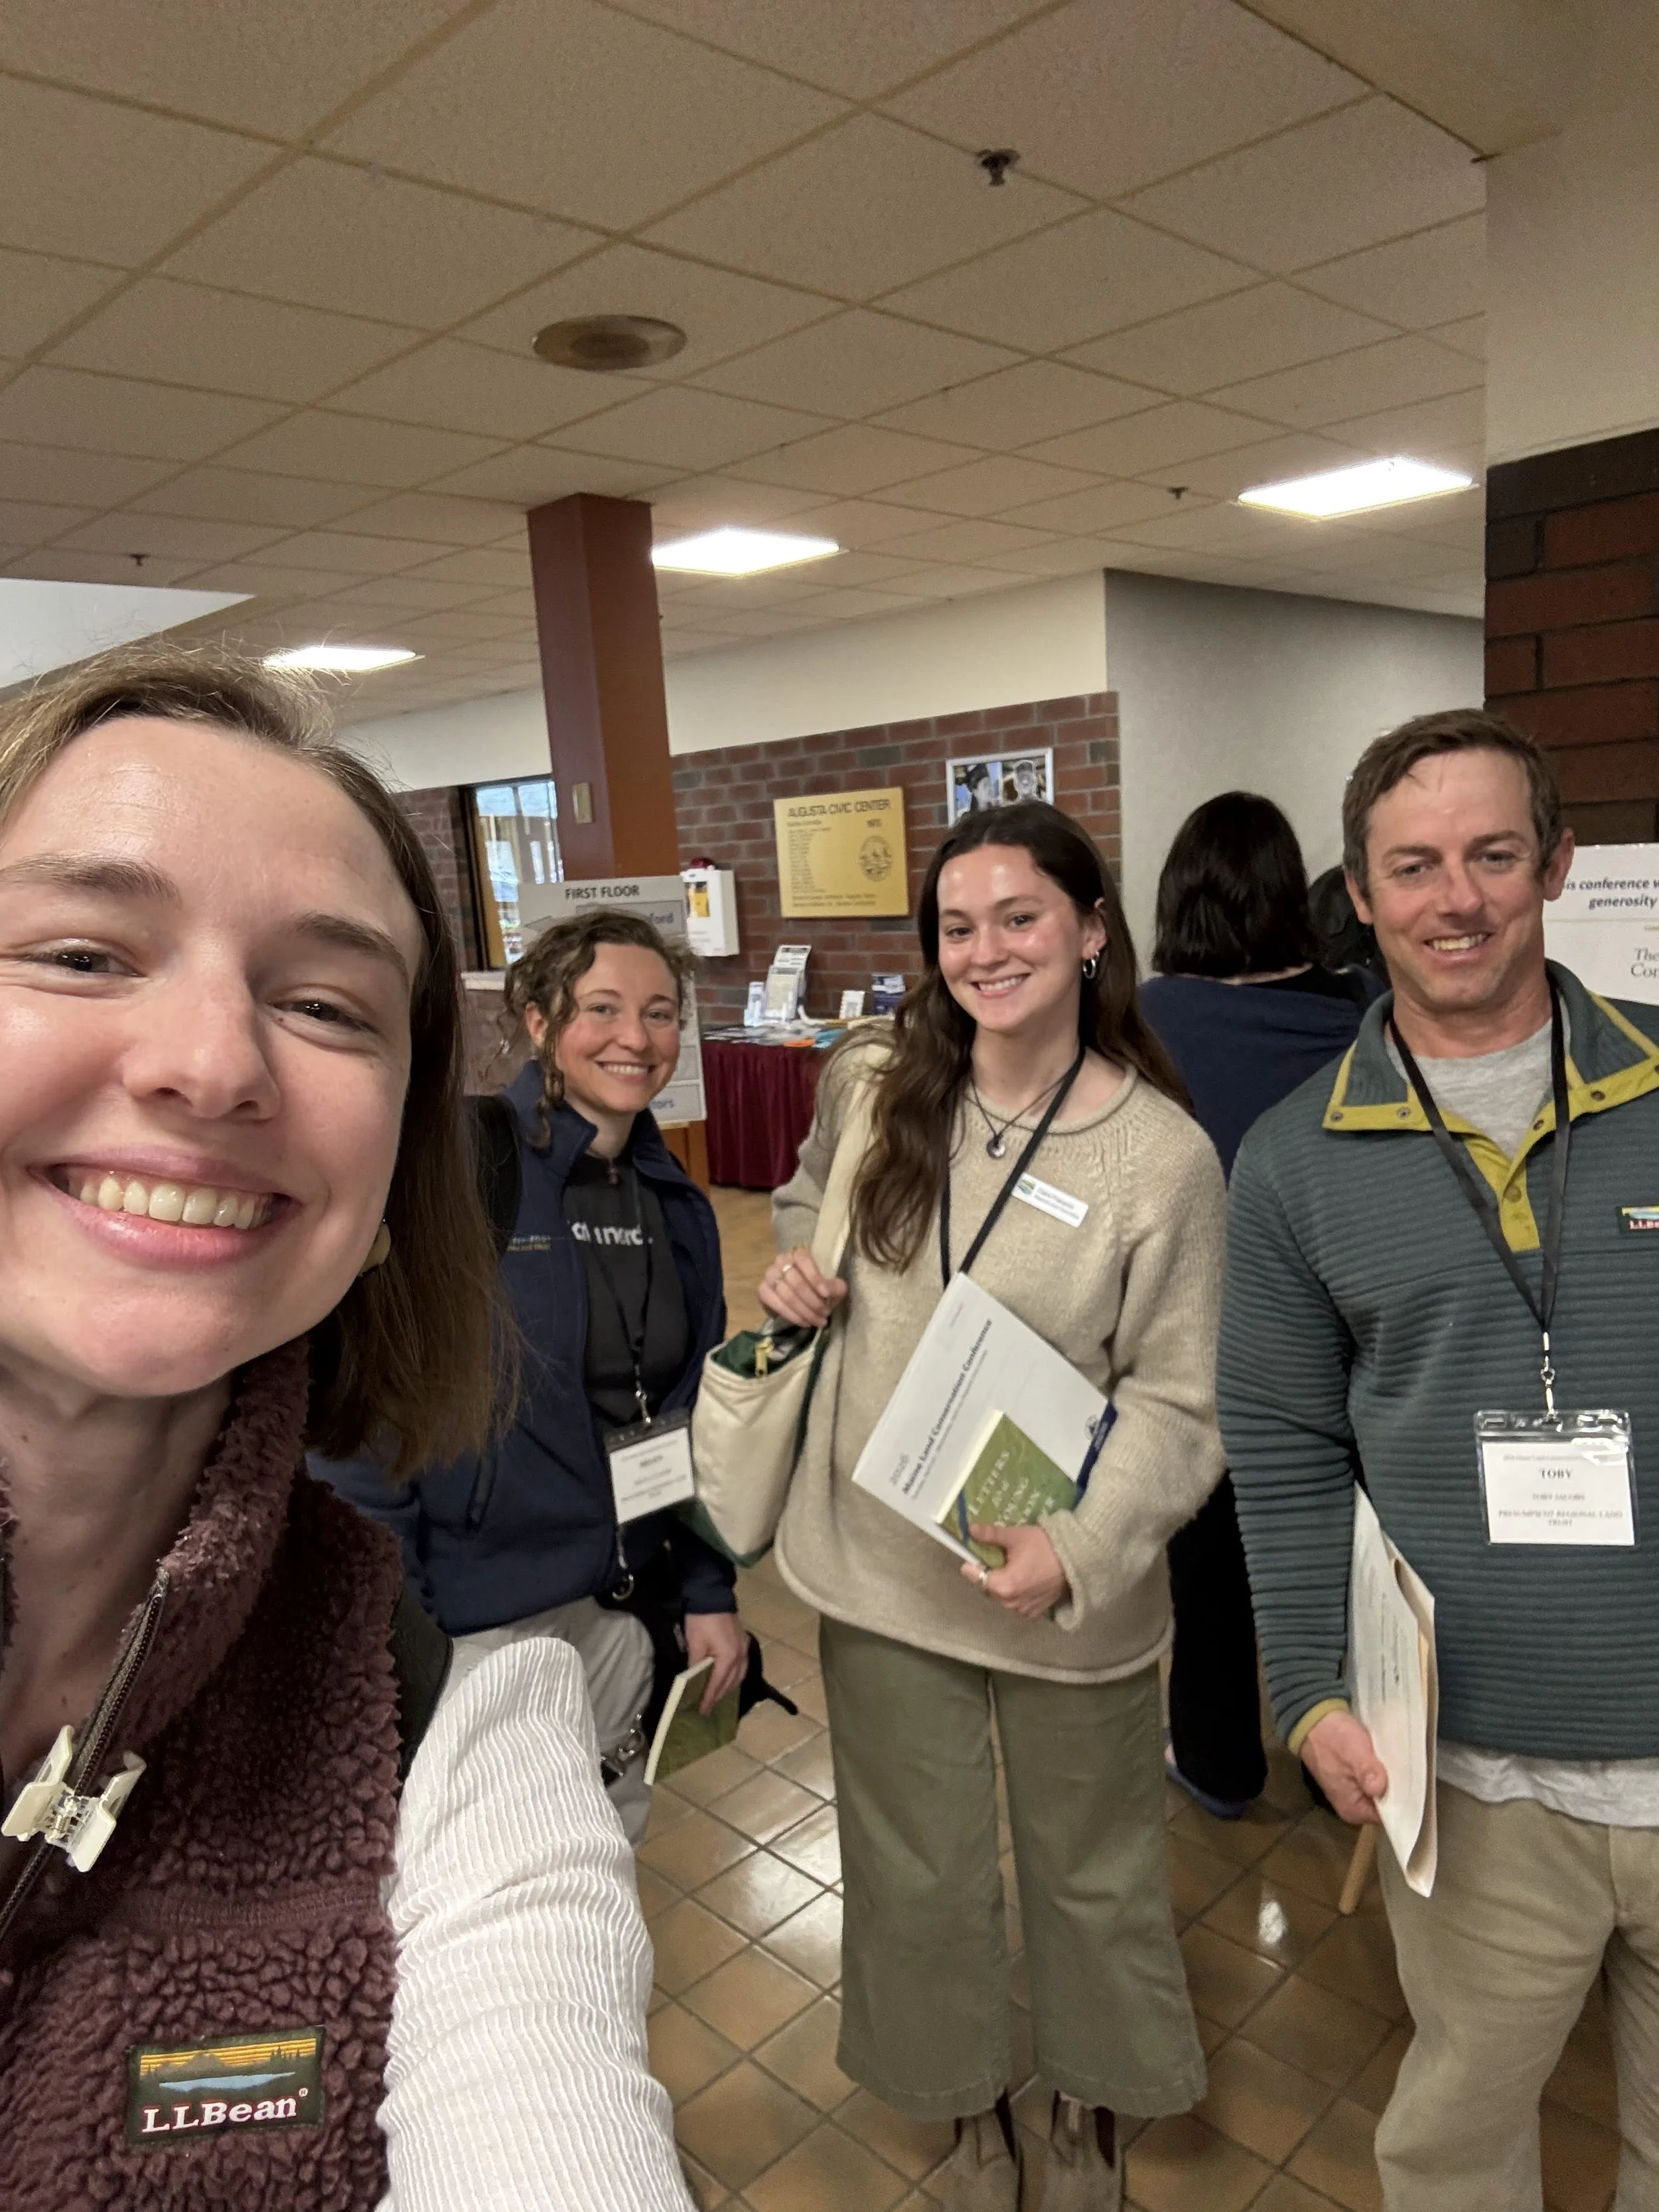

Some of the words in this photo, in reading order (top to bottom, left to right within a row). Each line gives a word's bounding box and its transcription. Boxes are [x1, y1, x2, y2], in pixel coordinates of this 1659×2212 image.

[788, 805, 827, 818] AUGUSTA
[828, 802, 852, 814] CIVIC
[854, 798, 891, 812] CENTER
[1579, 876, 1650, 891] conference
[565, 887, 597, 899] FIRST
[601, 885, 640, 898] FLOOR
[1588, 893, 1658, 911] generosity
[901, 1461, 923, 1495] Maine
[919, 1435, 936, 1462] Land
[931, 1372, 966, 1436] Conservation
[962, 1317, 993, 1372] Conference
[1539, 1468, 1572, 1479] TOBY
[1532, 1493, 1553, 1501] TOBY
